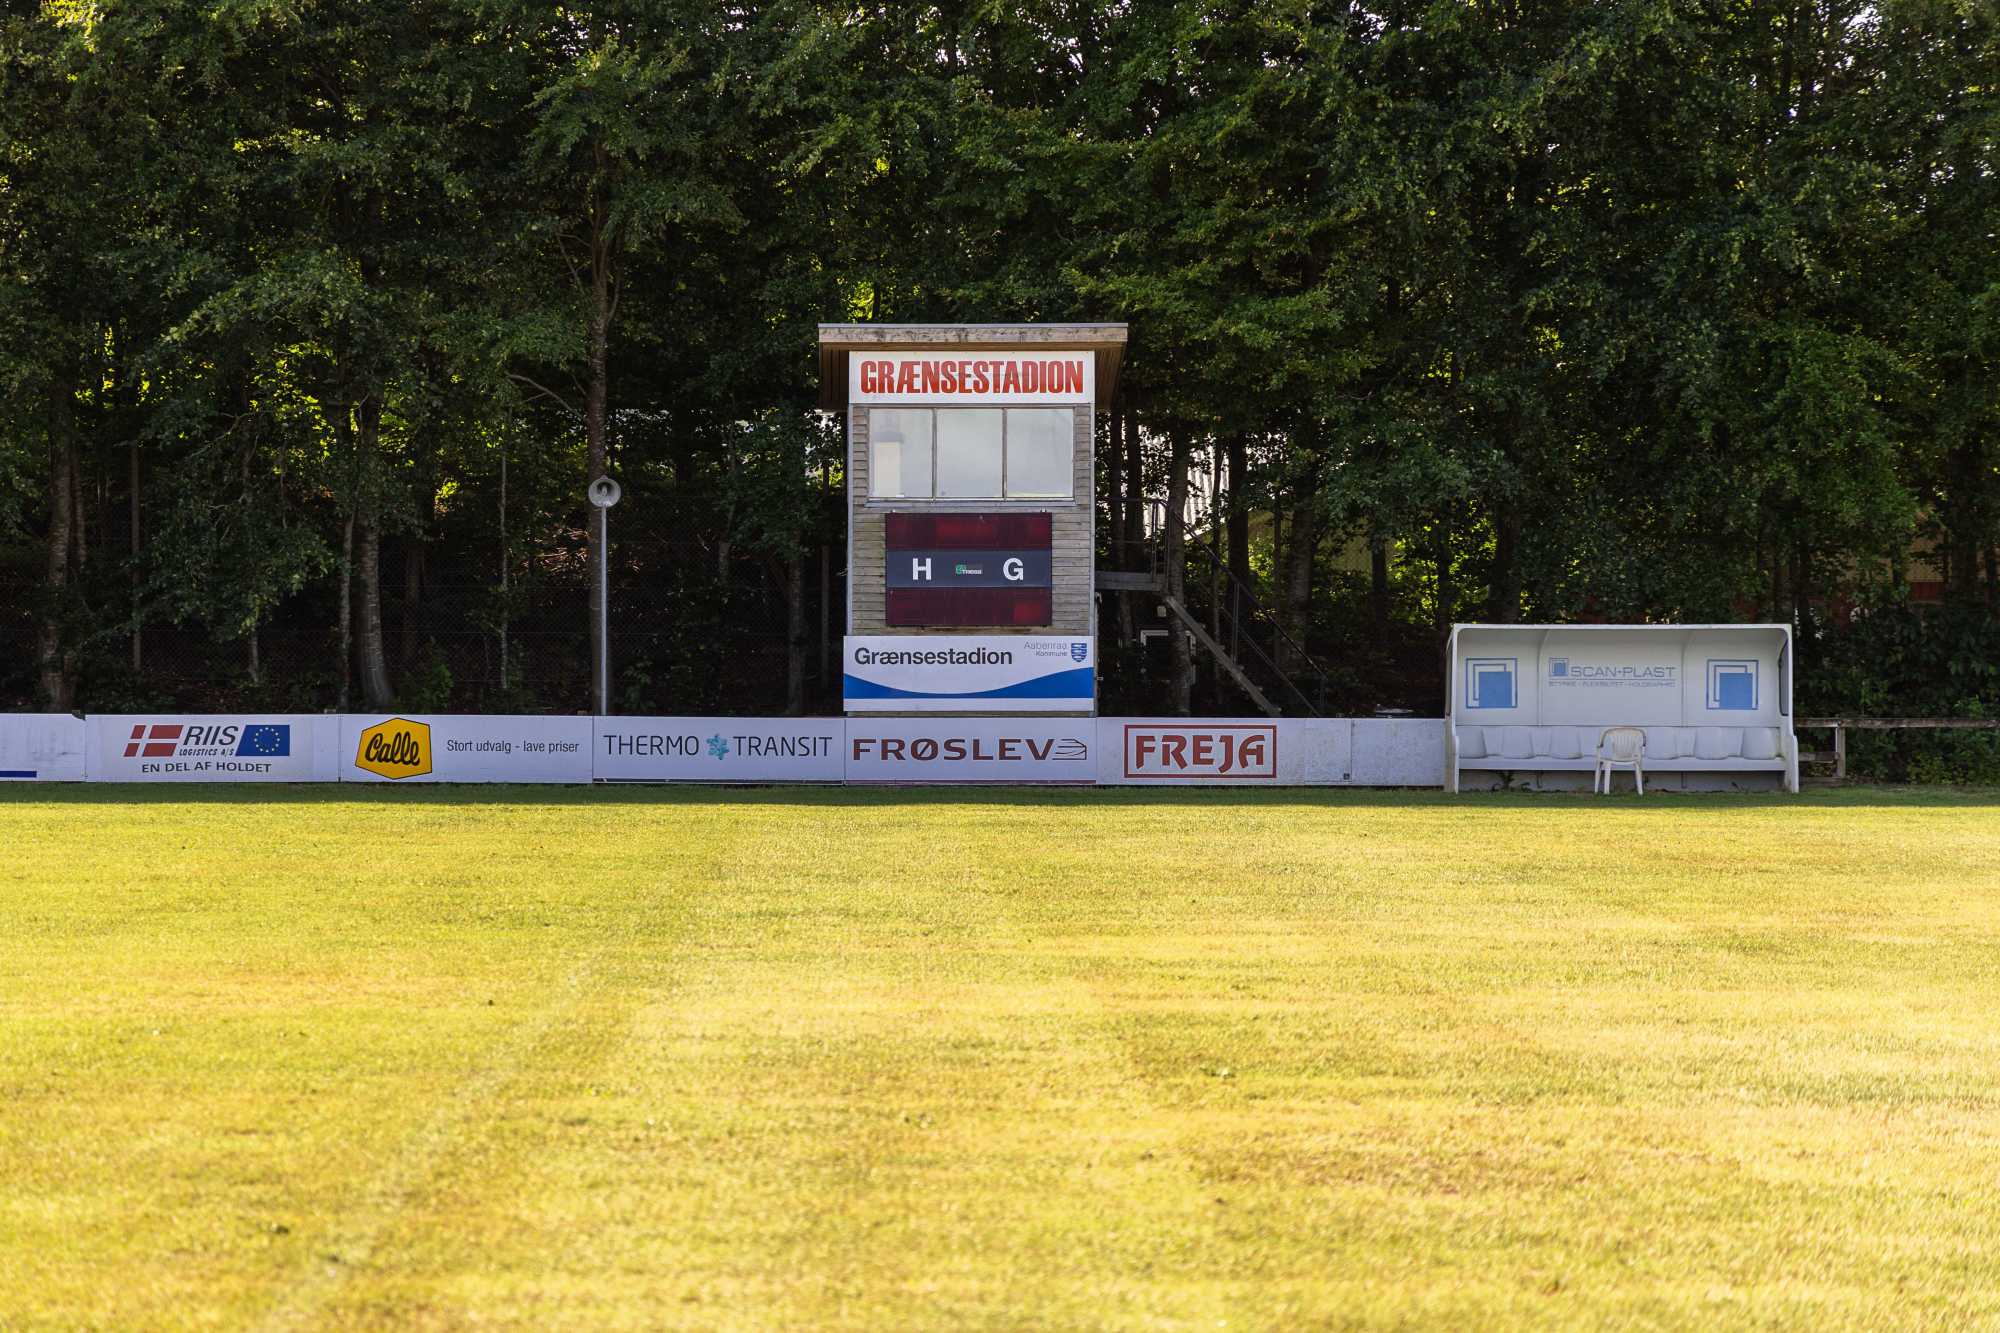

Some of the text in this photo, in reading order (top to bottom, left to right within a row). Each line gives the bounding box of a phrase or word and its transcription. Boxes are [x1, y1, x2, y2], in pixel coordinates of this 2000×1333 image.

[860, 360, 1084, 394] GRÆNSESTADION
[912, 557, 932, 581] H
[1003, 557, 1024, 581] G
[854, 646, 1013, 665] Grænsestadion
[183, 725, 239, 746] RIIS
[447, 739, 473, 752] Stort
[476, 740, 511, 754] udvalg
[523, 740, 545, 752] lave
[548, 740, 580, 754] priser
[603, 734, 833, 757] THERMO TRANSIT
[179, 748, 235, 757] LOGISTICS A/S
[364, 731, 421, 766] Calle
[852, 738, 1056, 761] FRØSLEV
[1135, 734, 1266, 774] FREJA
[142, 761, 272, 773] EN DEL AF HOLDET
